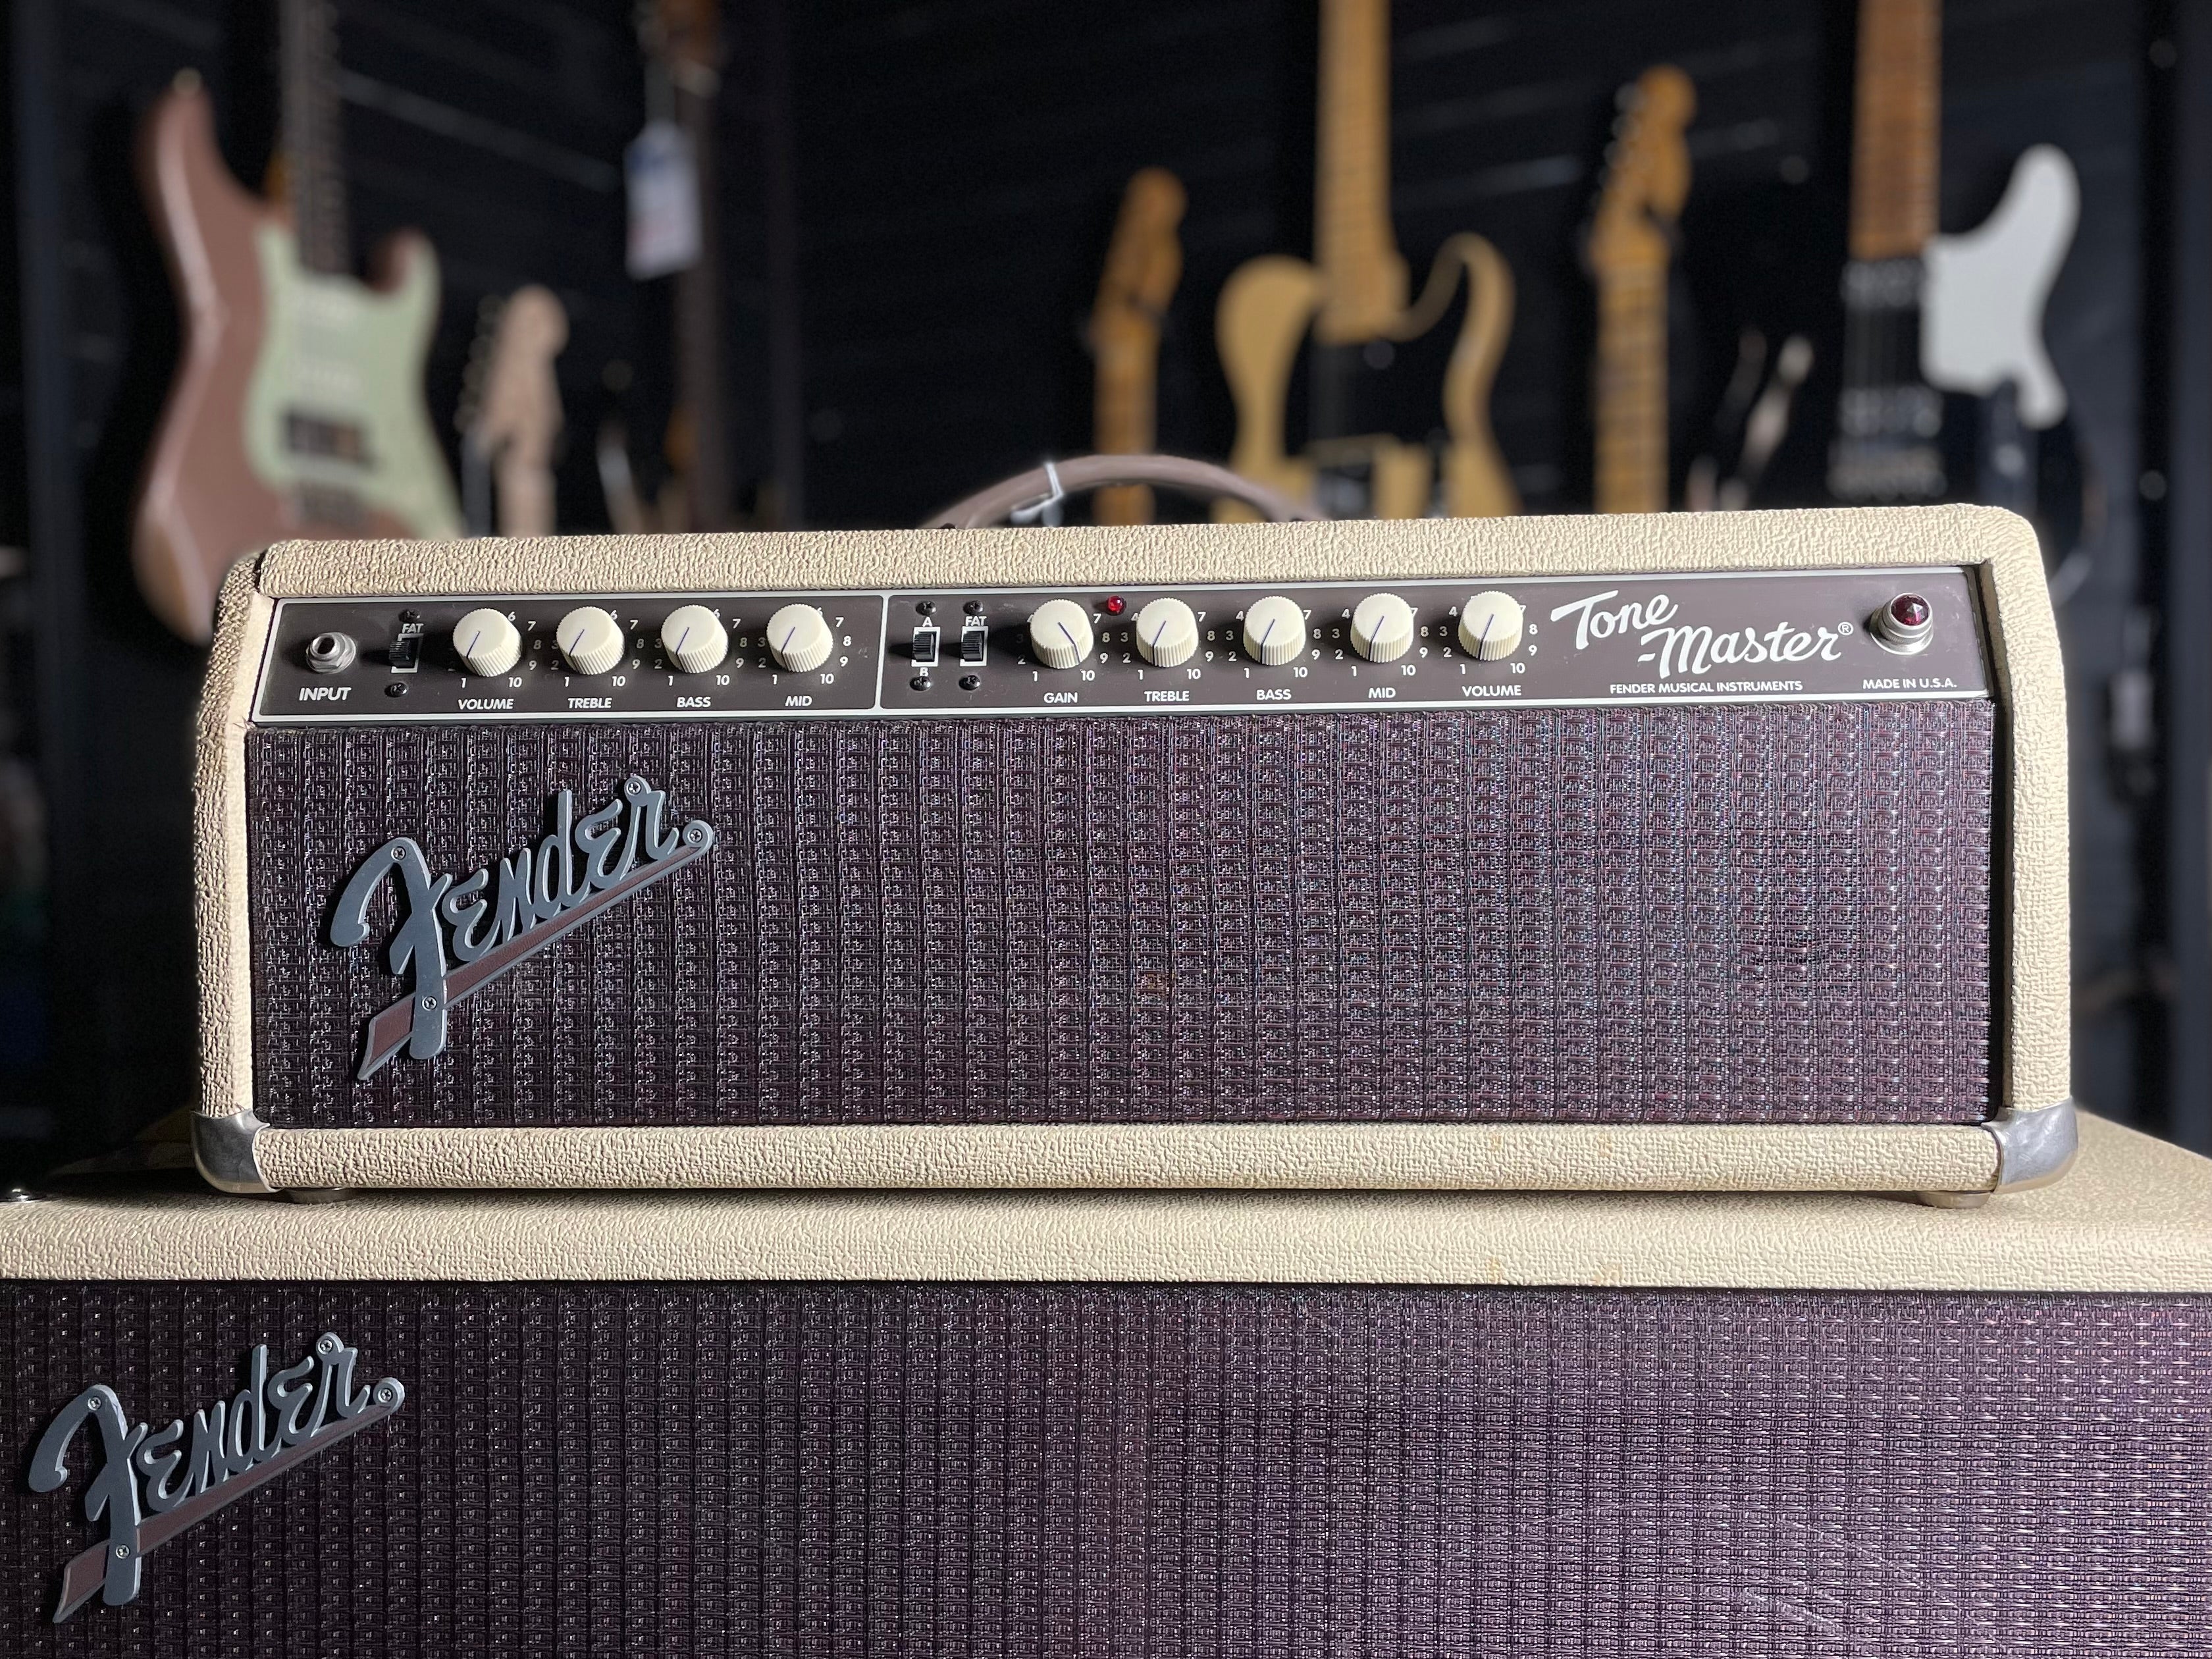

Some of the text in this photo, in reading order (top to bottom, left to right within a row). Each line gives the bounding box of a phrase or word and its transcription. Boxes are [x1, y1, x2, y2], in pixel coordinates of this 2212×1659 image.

[610, 610, 618, 620] 6
[1236, 611, 1244, 621] 4
[1304, 610, 1311, 619] 7
[1342, 609, 1350, 619] 4
[1449, 606, 1458, 616] 4
[508, 612, 515, 621] 6
[966, 616, 986, 626] FAT
[1093, 614, 1101, 623] 7
[1131, 613, 1138, 621] 4
[1198, 612, 1206, 621] 7
[1550, 590, 1679, 650] Tone
[528, 621, 536, 631] 7
[630, 620, 638, 630] 7
[732, 619, 741, 629] 7
[835, 617, 844, 627] 7
[922, 617, 932, 627] A
[402, 623, 423, 633] FAT
[1421, 627, 1429, 637] 8
[1440, 627, 1448, 637] 3
[1529, 624, 1538, 634] 8
[1101, 633, 1110, 643] 8
[1120, 632, 1128, 642] 3
[1207, 631, 1215, 641] 8
[1226, 631, 1234, 641] 3
[1313, 629, 1321, 639] 8
[1332, 629, 1340, 639] 3
[533, 640, 541, 650] 8
[637, 639, 645, 648] 8
[654, 639, 662, 648] 3
[739, 637, 748, 647] 8
[758, 637, 765, 647] 3
[843, 636, 851, 646] 8
[1311, 649, 1321, 660] 9
[1335, 649, 1344, 660] 2
[1419, 647, 1428, 658] 9
[1443, 647, 1452, 657] 2
[1528, 645, 1537, 656] 9
[1018, 655, 1026, 665] 2
[1099, 653, 1109, 664] 9
[1122, 653, 1131, 663] 2
[1205, 651, 1214, 662] 9
[1228, 651, 1237, 662] 2
[529, 660, 537, 671] 9
[550, 660, 558, 670] 2
[632, 659, 641, 669] 9
[654, 659, 662, 669] 2
[736, 658, 744, 668] 9
[758, 658, 766, 668] 2
[839, 657, 848, 667] 9
[920, 668, 929, 677] B
[1244, 668, 1250, 678] 1
[1293, 667, 1307, 677] 10
[1351, 666, 1357, 677] 1
[1401, 664, 1415, 675] 10
[1460, 664, 1466, 674] 1
[1510, 663, 1525, 673] 10
[820, 673, 834, 684] 10
[1032, 672, 1038, 681] 1
[1081, 670, 1095, 681] 10
[1138, 670, 1144, 679] 1
[1186, 668, 1201, 679] 10
[461, 677, 467, 688] 1
[508, 677, 521, 688] 10
[564, 677, 569, 687] 1
[612, 676, 626, 687] 10
[668, 675, 673, 686] 1
[716, 675, 730, 685] 10
[772, 674, 777, 685] 1
[1863, 678, 1957, 689] MADE IN U.S.A.
[1462, 685, 1521, 697] VOLUME
[1610, 680, 1803, 694] FENDER MUSICAL INSTRUMENTS
[299, 687, 352, 701] INPUT
[1144, 691, 1190, 701] TREBLE
[1257, 689, 1292, 700] BASS
[1369, 687, 1396, 698] MID
[567, 697, 612, 708] TREBLE
[677, 697, 711, 708] BASS
[785, 695, 812, 706] MID
[1043, 692, 1078, 704] GAIN
[458, 698, 514, 710] VOLUME
[330, 775, 714, 1080] Fender
[28, 1332, 406, 1624] Fender
